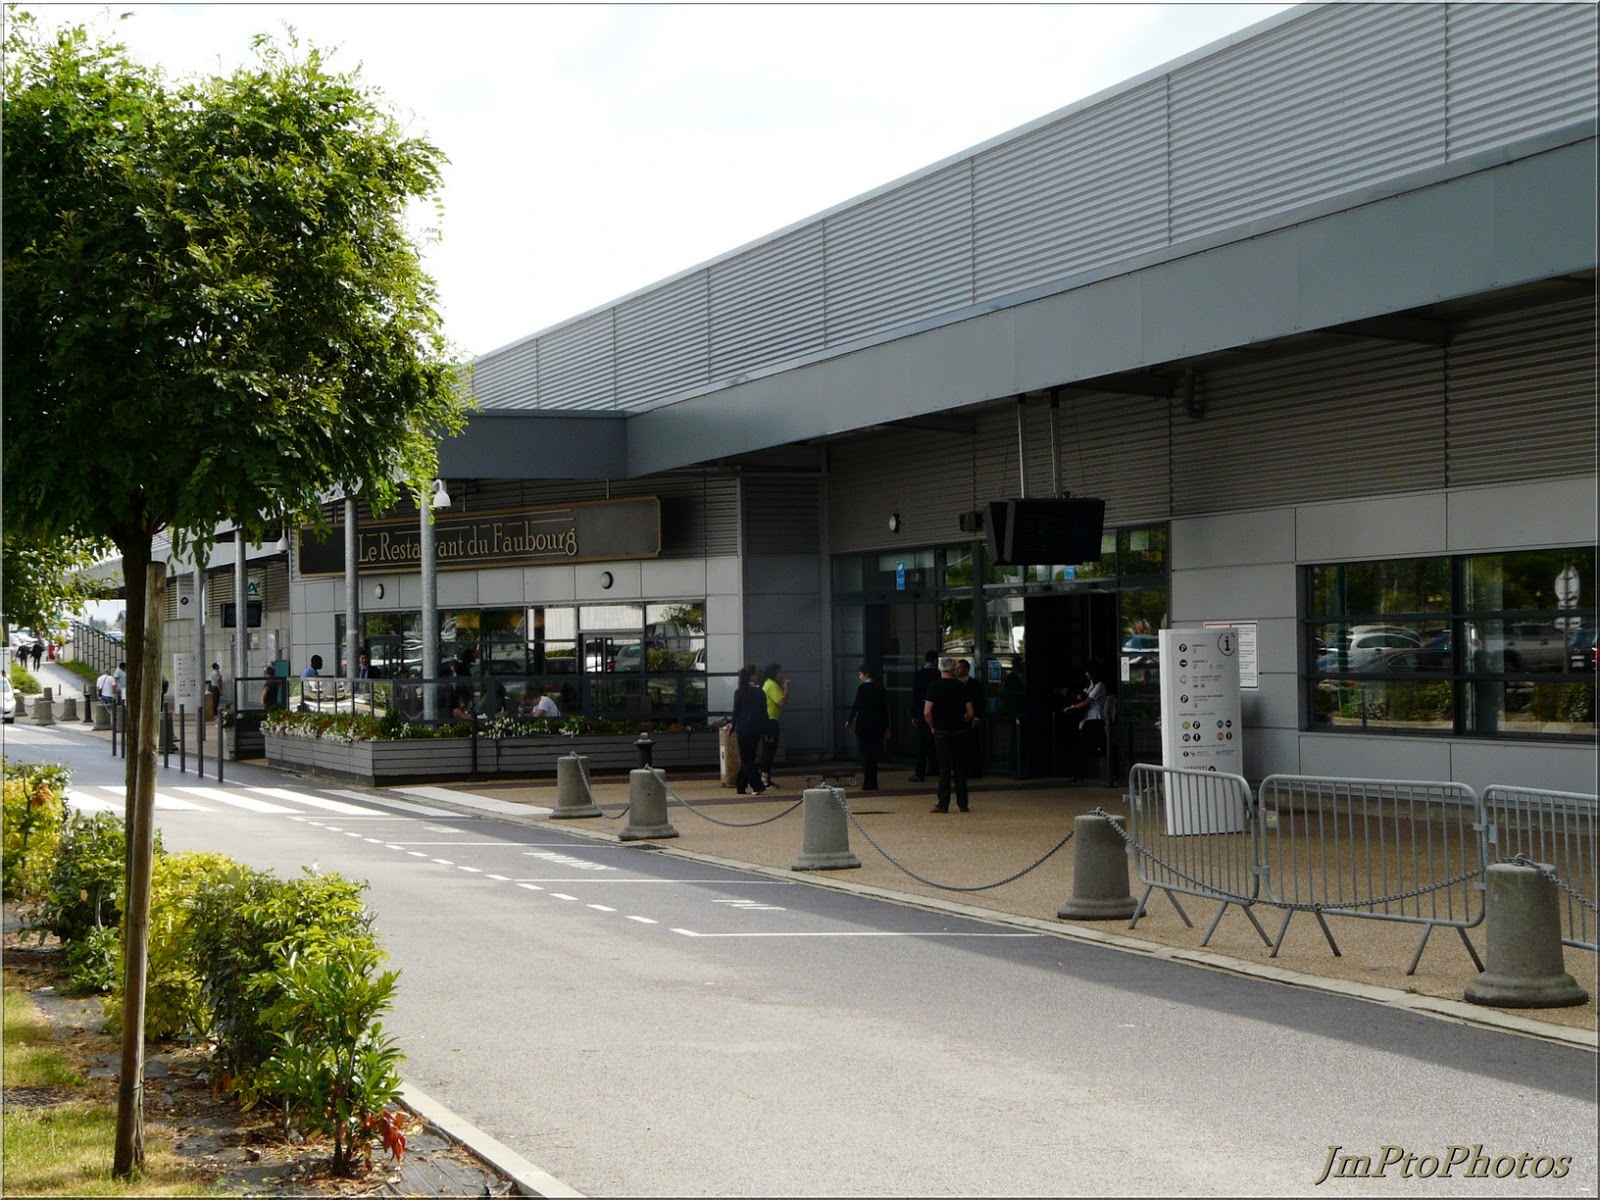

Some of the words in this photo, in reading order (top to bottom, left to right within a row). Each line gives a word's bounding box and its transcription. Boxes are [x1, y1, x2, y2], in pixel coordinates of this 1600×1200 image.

[358, 533, 378, 562] Le
[379, 531, 464, 561] Restaant
[468, 525, 489, 556] du
[493, 521, 577, 556] Faubourg
